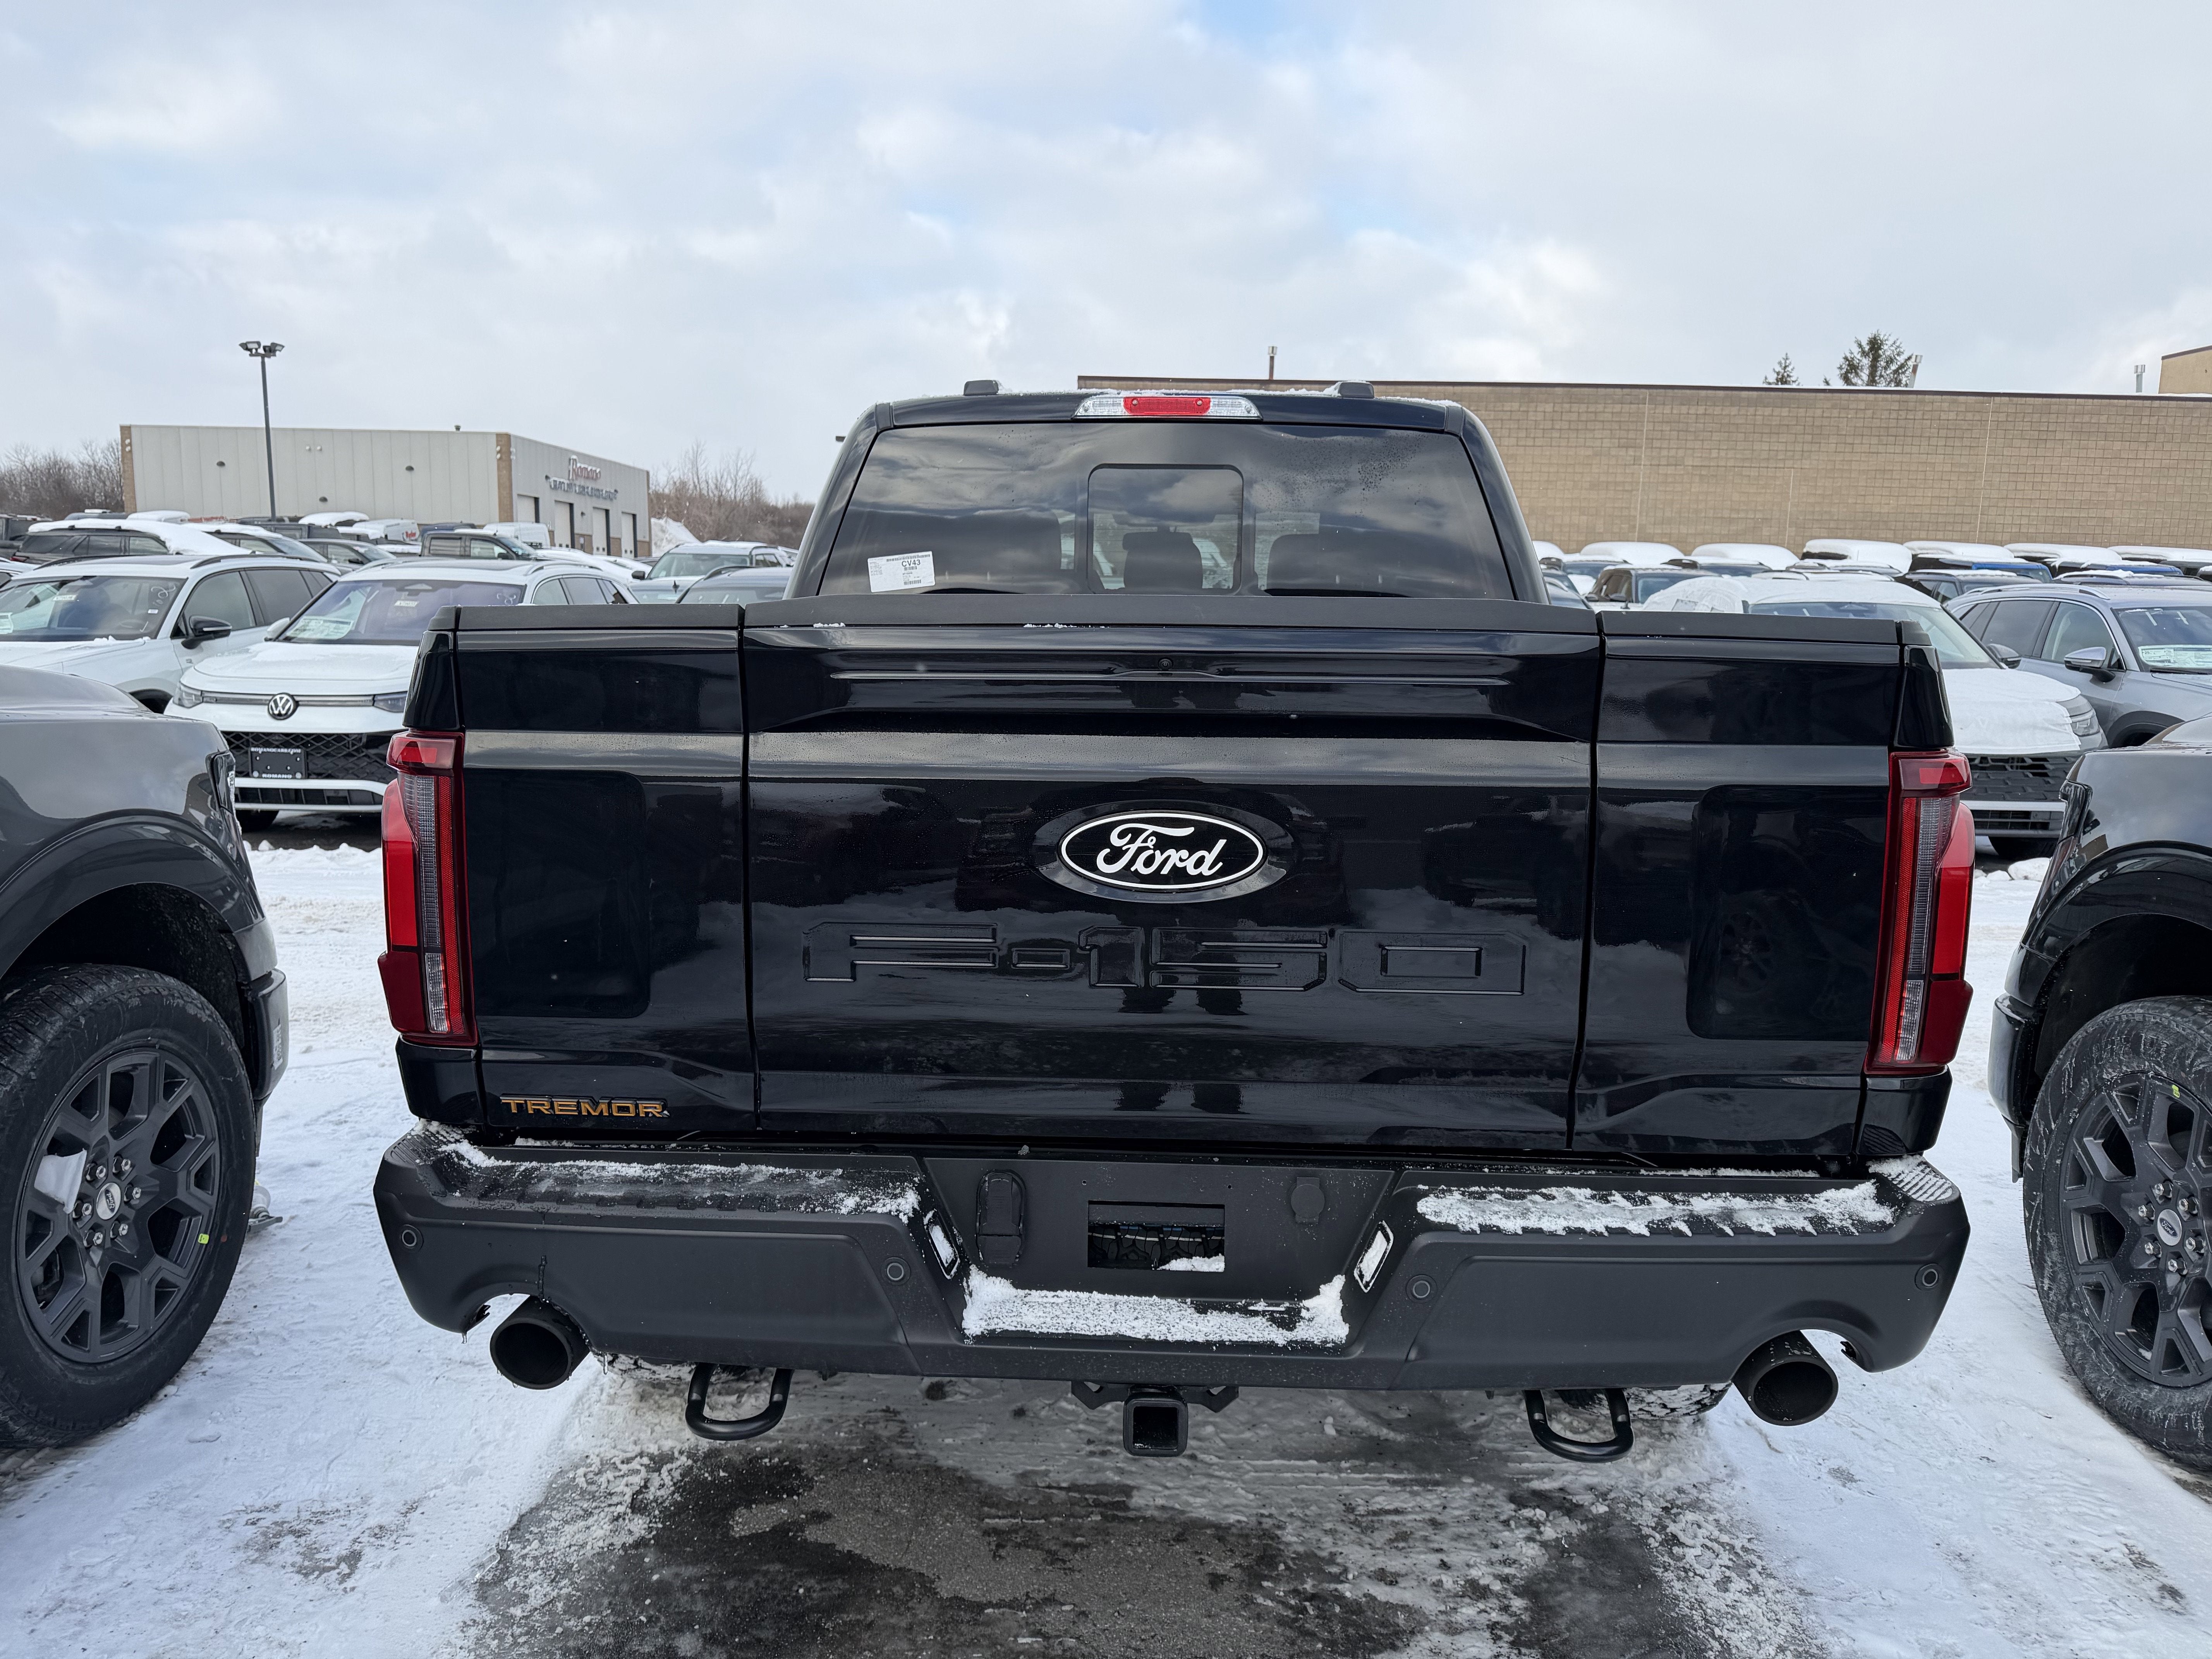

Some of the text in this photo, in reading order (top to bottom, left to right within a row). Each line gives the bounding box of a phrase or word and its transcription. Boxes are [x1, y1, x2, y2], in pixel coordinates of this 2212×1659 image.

[1096, 823, 1227, 876] Ford
[802, 921, 1527, 996] F-150
[500, 1096, 670, 1118] TREMOR
[106, 1192, 115, 1209] Ford
[2162, 1221, 2174, 1235] Ford
